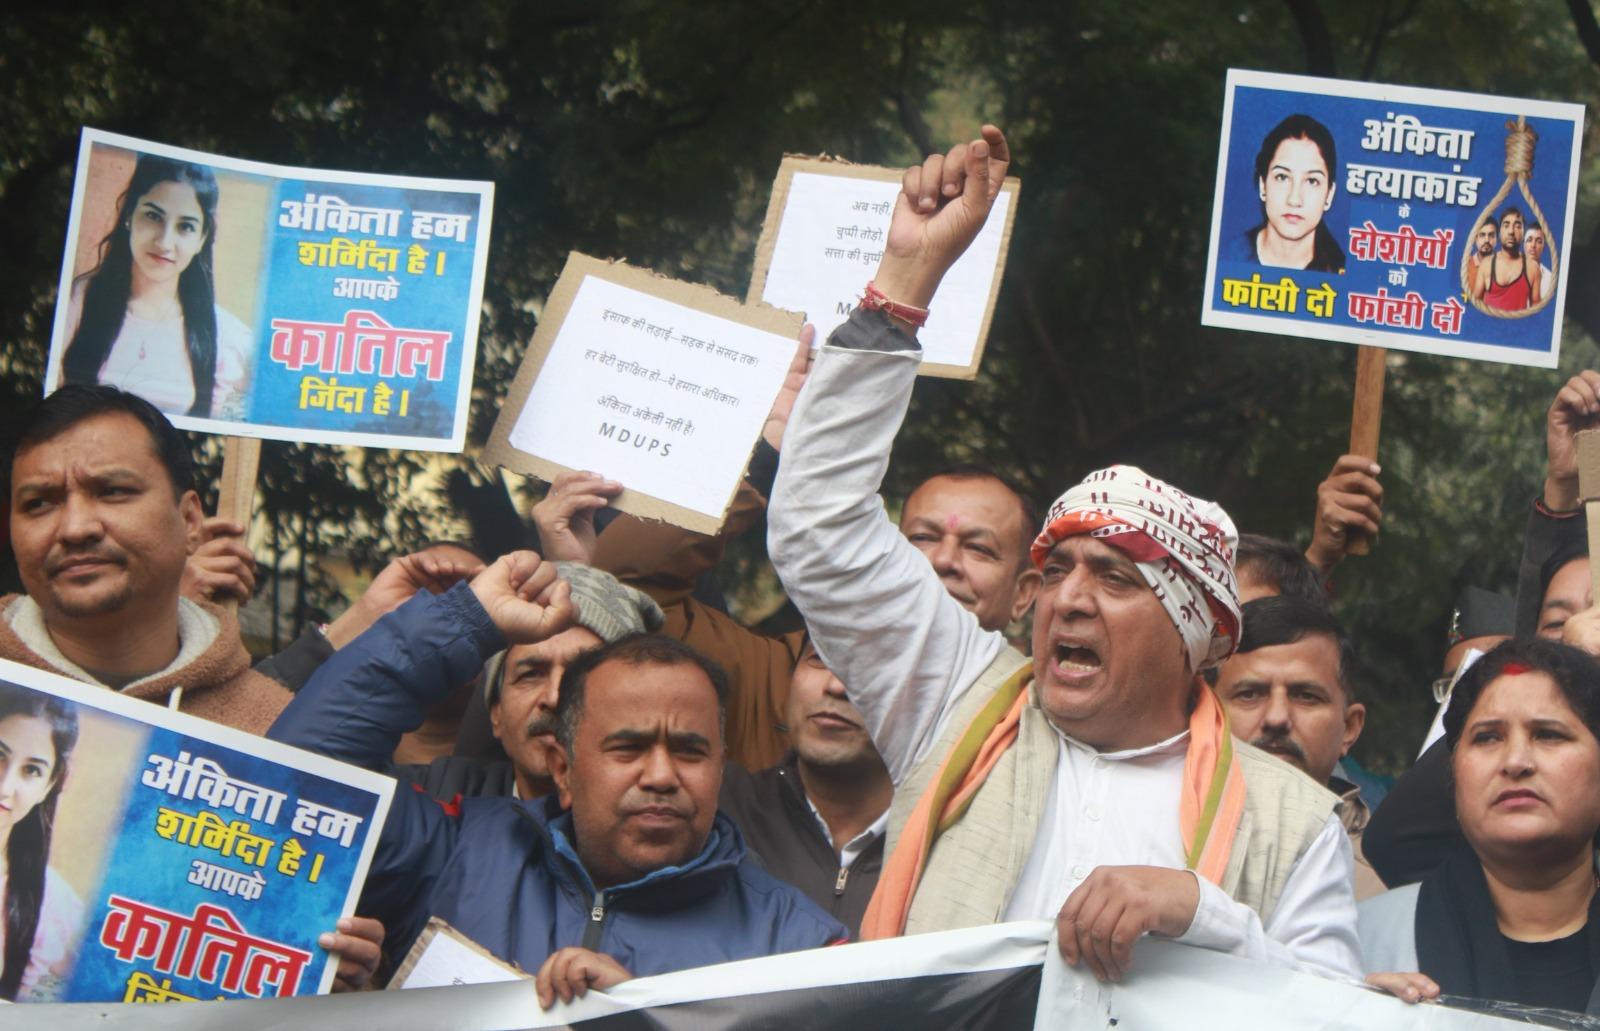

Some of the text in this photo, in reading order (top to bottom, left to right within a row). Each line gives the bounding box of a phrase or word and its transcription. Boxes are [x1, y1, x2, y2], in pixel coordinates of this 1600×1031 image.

[1361, 112, 1475, 160] अंकिता
[852, 201, 870, 213] अब
[1346, 164, 1482, 207] हत्याकांड
[278, 193, 471, 242] अंकिता हम
[1398, 203, 1411, 219] के
[298, 237, 400, 272] शर्मिंदा
[847, 248, 861, 261] की
[1350, 220, 1455, 269] दोशीयों
[332, 276, 401, 301] आपके
[1223, 273, 1337, 317] फांसी दो
[1388, 267, 1409, 287] को
[1348, 287, 1466, 335] फांसी दो
[270, 309, 452, 382] कातिल
[631, 317, 646, 331] की
[705, 339, 716, 354] से
[585, 348, 599, 361] हर
[598, 350, 617, 369] बेटी
[675, 379, 701, 395] हमारा
[300, 376, 367, 413] जिंदा
[633, 407, 664, 426] अकेली
[141, 751, 364, 848] अंकिता हम
[155, 807, 275, 868] शर्मिंदा
[187, 859, 266, 901] आपके
[99, 894, 313, 999] कातिल
